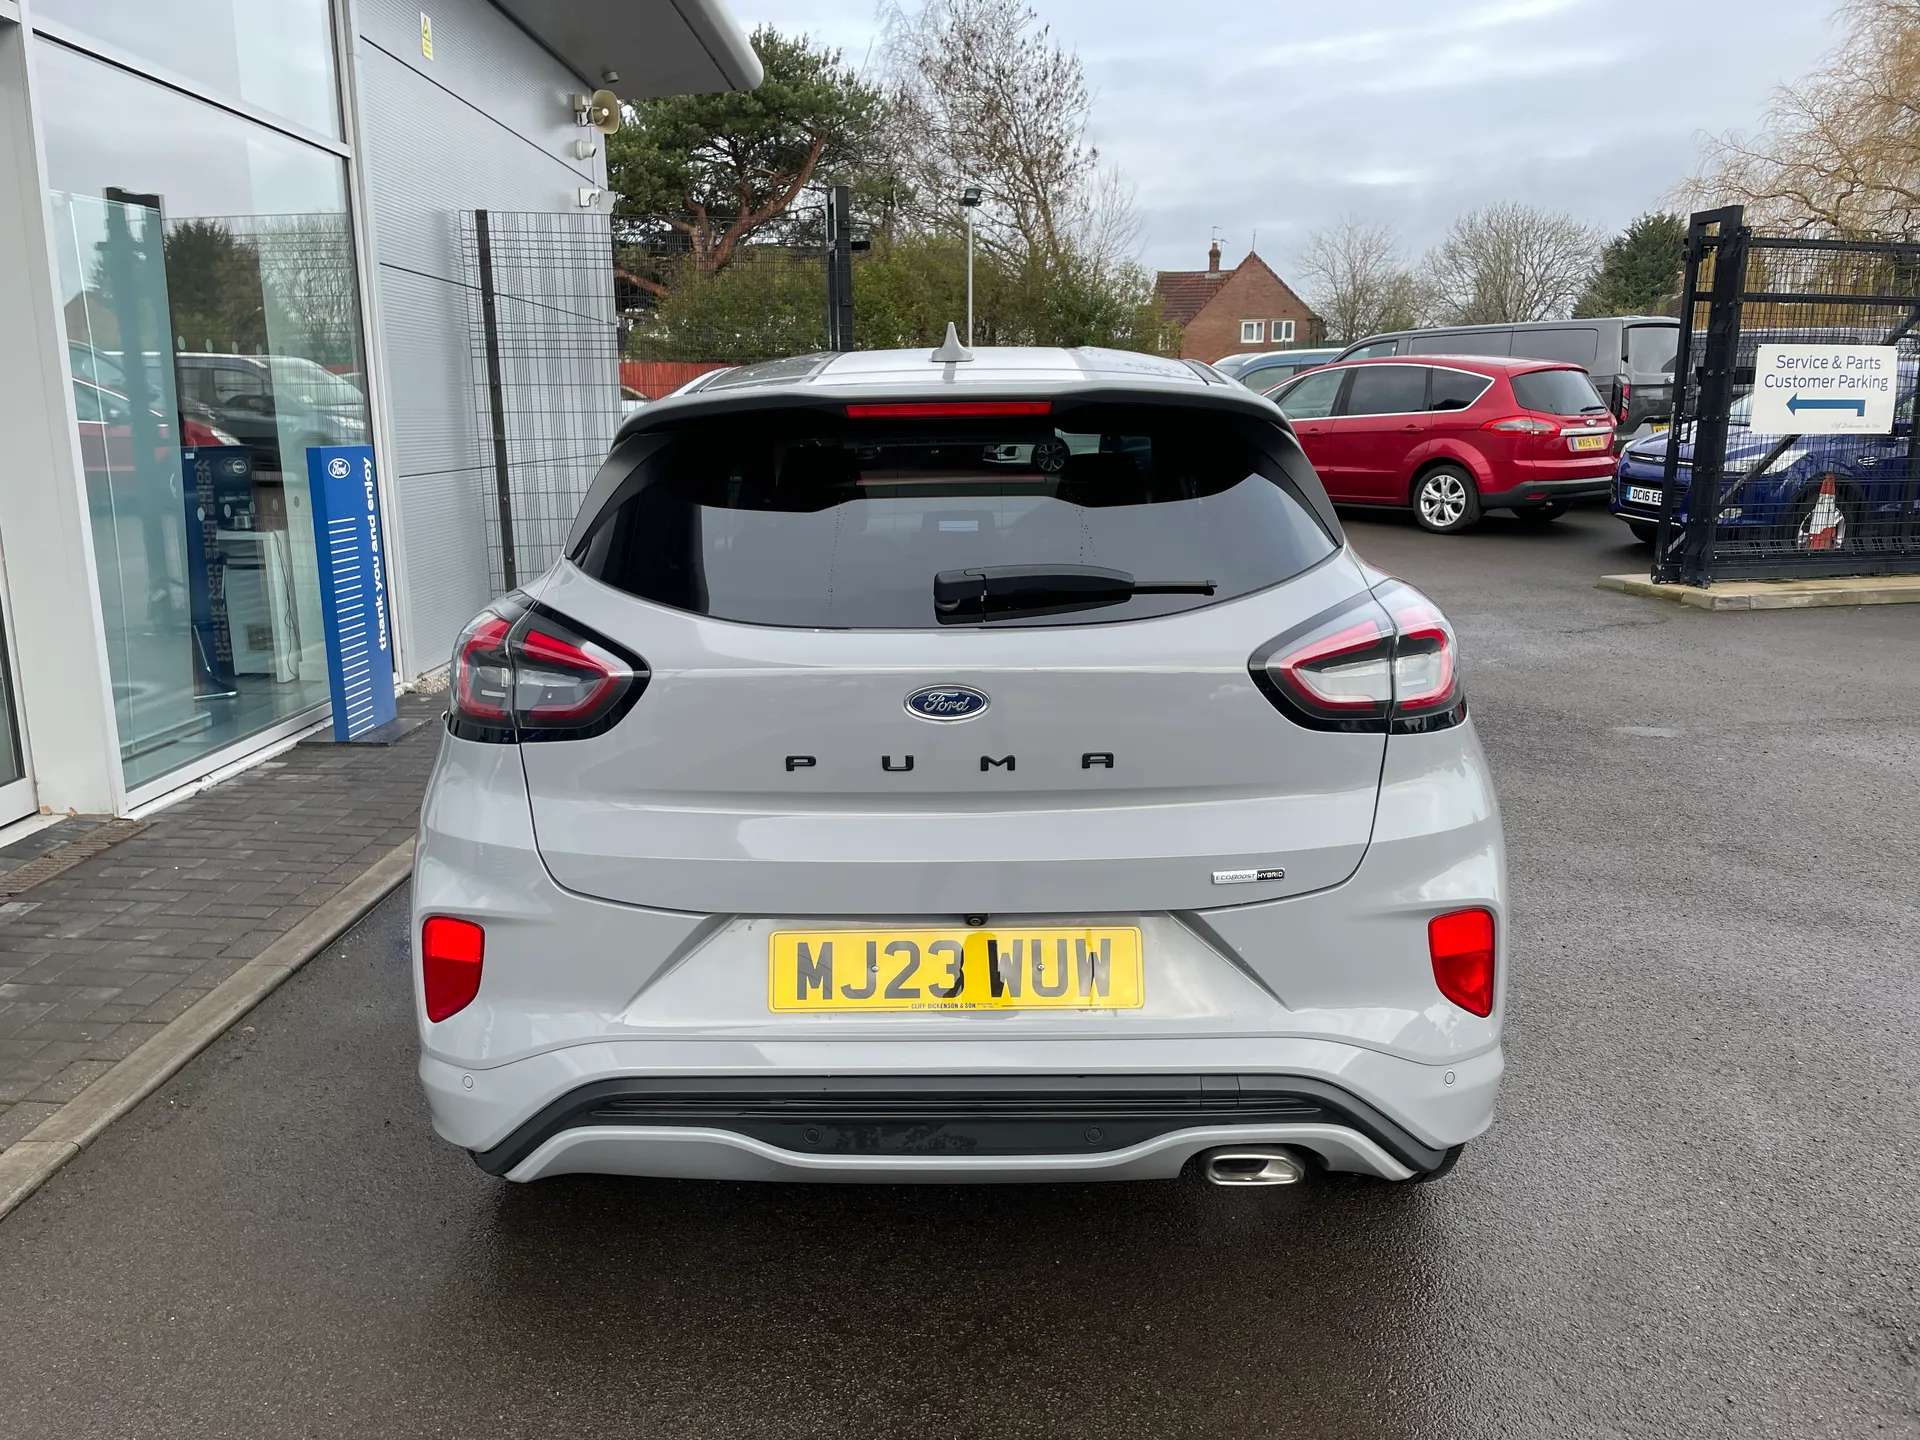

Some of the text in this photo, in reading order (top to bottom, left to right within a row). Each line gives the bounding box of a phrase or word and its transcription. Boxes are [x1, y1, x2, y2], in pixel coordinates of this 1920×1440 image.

[1776, 354, 1881, 370] Service & Parts
[1764, 374, 1889, 391] Customer Parking
[331, 461, 348, 475] Ford
[1633, 489, 1650, 501] DC16
[363, 456, 387, 651] thank you and enjoy
[924, 692, 970, 712] Ford
[785, 752, 1115, 772] PUMA
[1215, 871, 1284, 881] ECOBOOST HYBRID
[796, 938, 1112, 1001] MJ23 WUW
